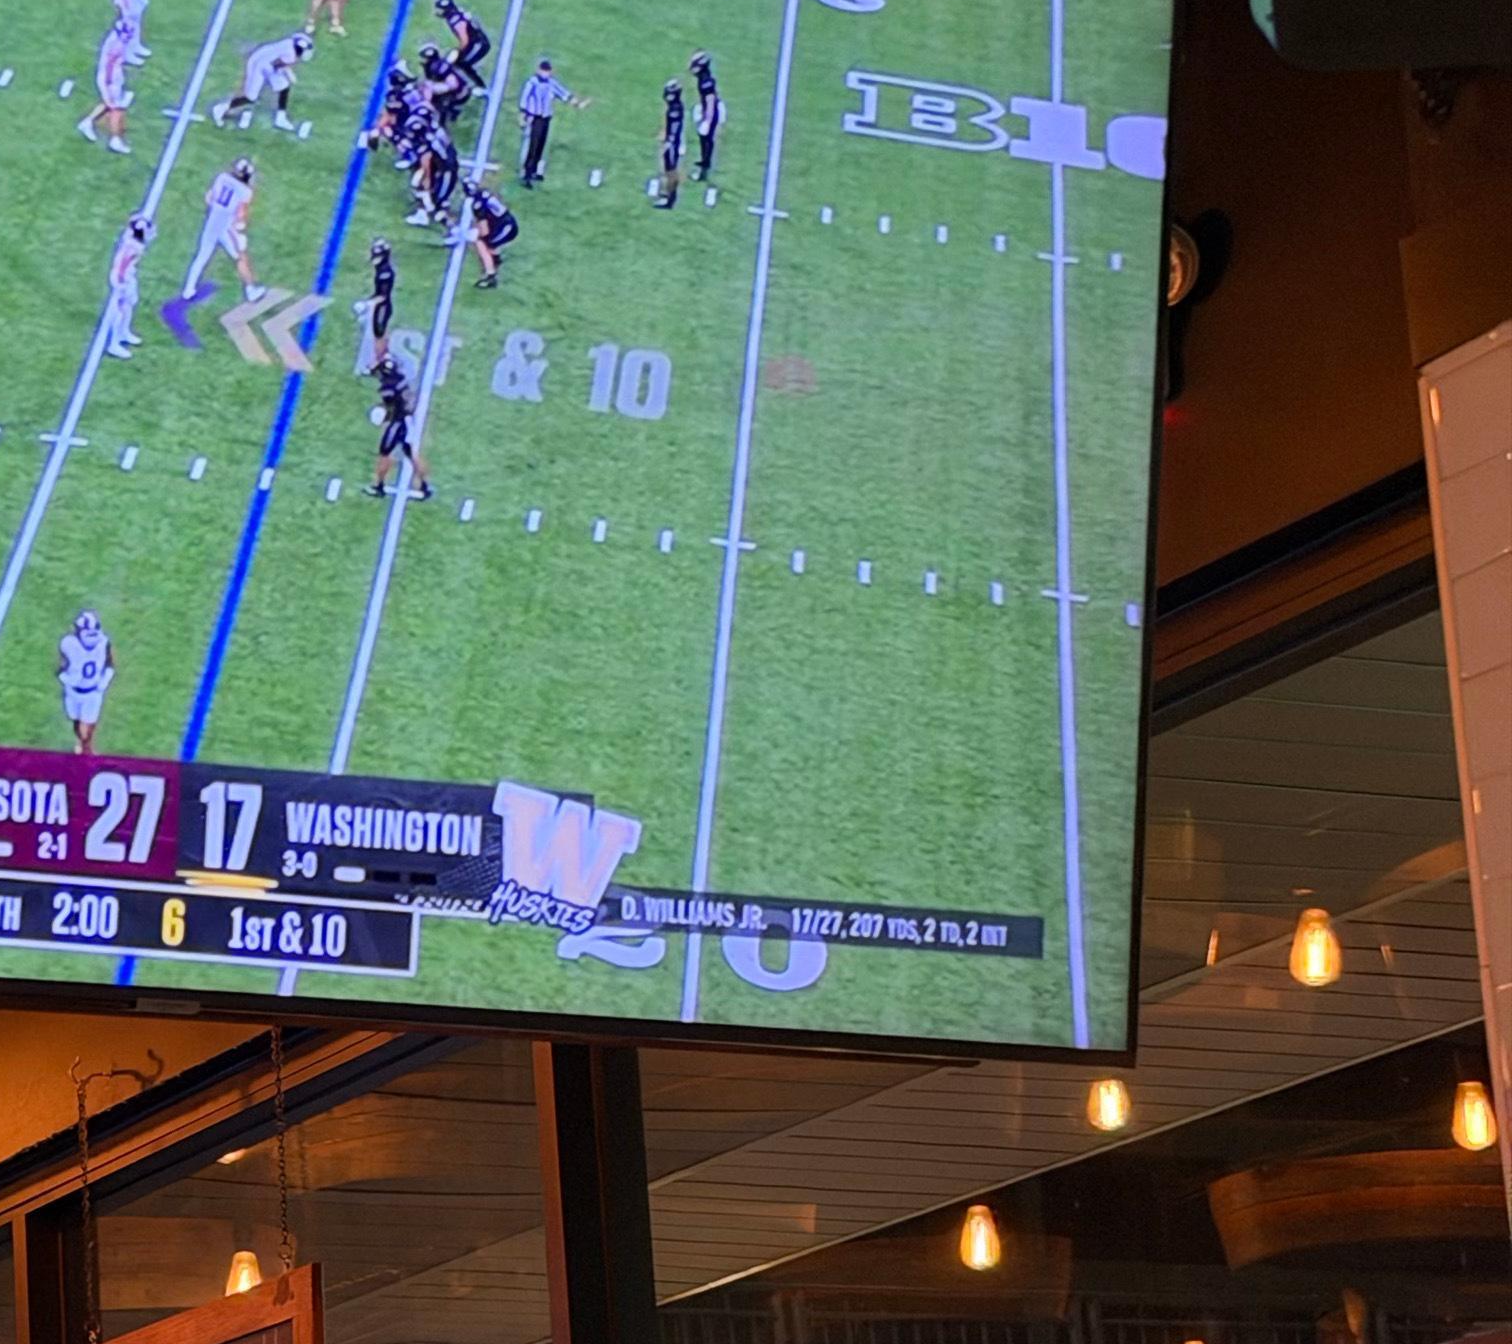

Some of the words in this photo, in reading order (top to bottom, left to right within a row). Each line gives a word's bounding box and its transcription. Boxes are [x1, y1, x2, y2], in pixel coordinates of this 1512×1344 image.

[491, 330, 550, 402] &
[588, 344, 673, 420] 10
[37, 831, 68, 860] 2-1
[85, 771, 166, 864] 27
[199, 781, 263, 871] 17
[286, 800, 483, 857] WASHINGTON
[492, 781, 643, 910] W
[281, 850, 319, 879] 3-0
[51, 892, 120, 940] 2:00
[161, 898, 186, 947] 6
[228, 906, 276, 953] 1ST
[278, 912, 304, 956] &
[308, 913, 348, 958] 10
[489, 880, 595, 934] HUSKIES
[621, 896, 641, 920] D.
[644, 897, 736, 928] WILLIAMS
[738, 903, 768, 931] JR.
[849, 912, 885, 938] 207
[923, 918, 936, 942] 2
[966, 921, 979, 945] 2
